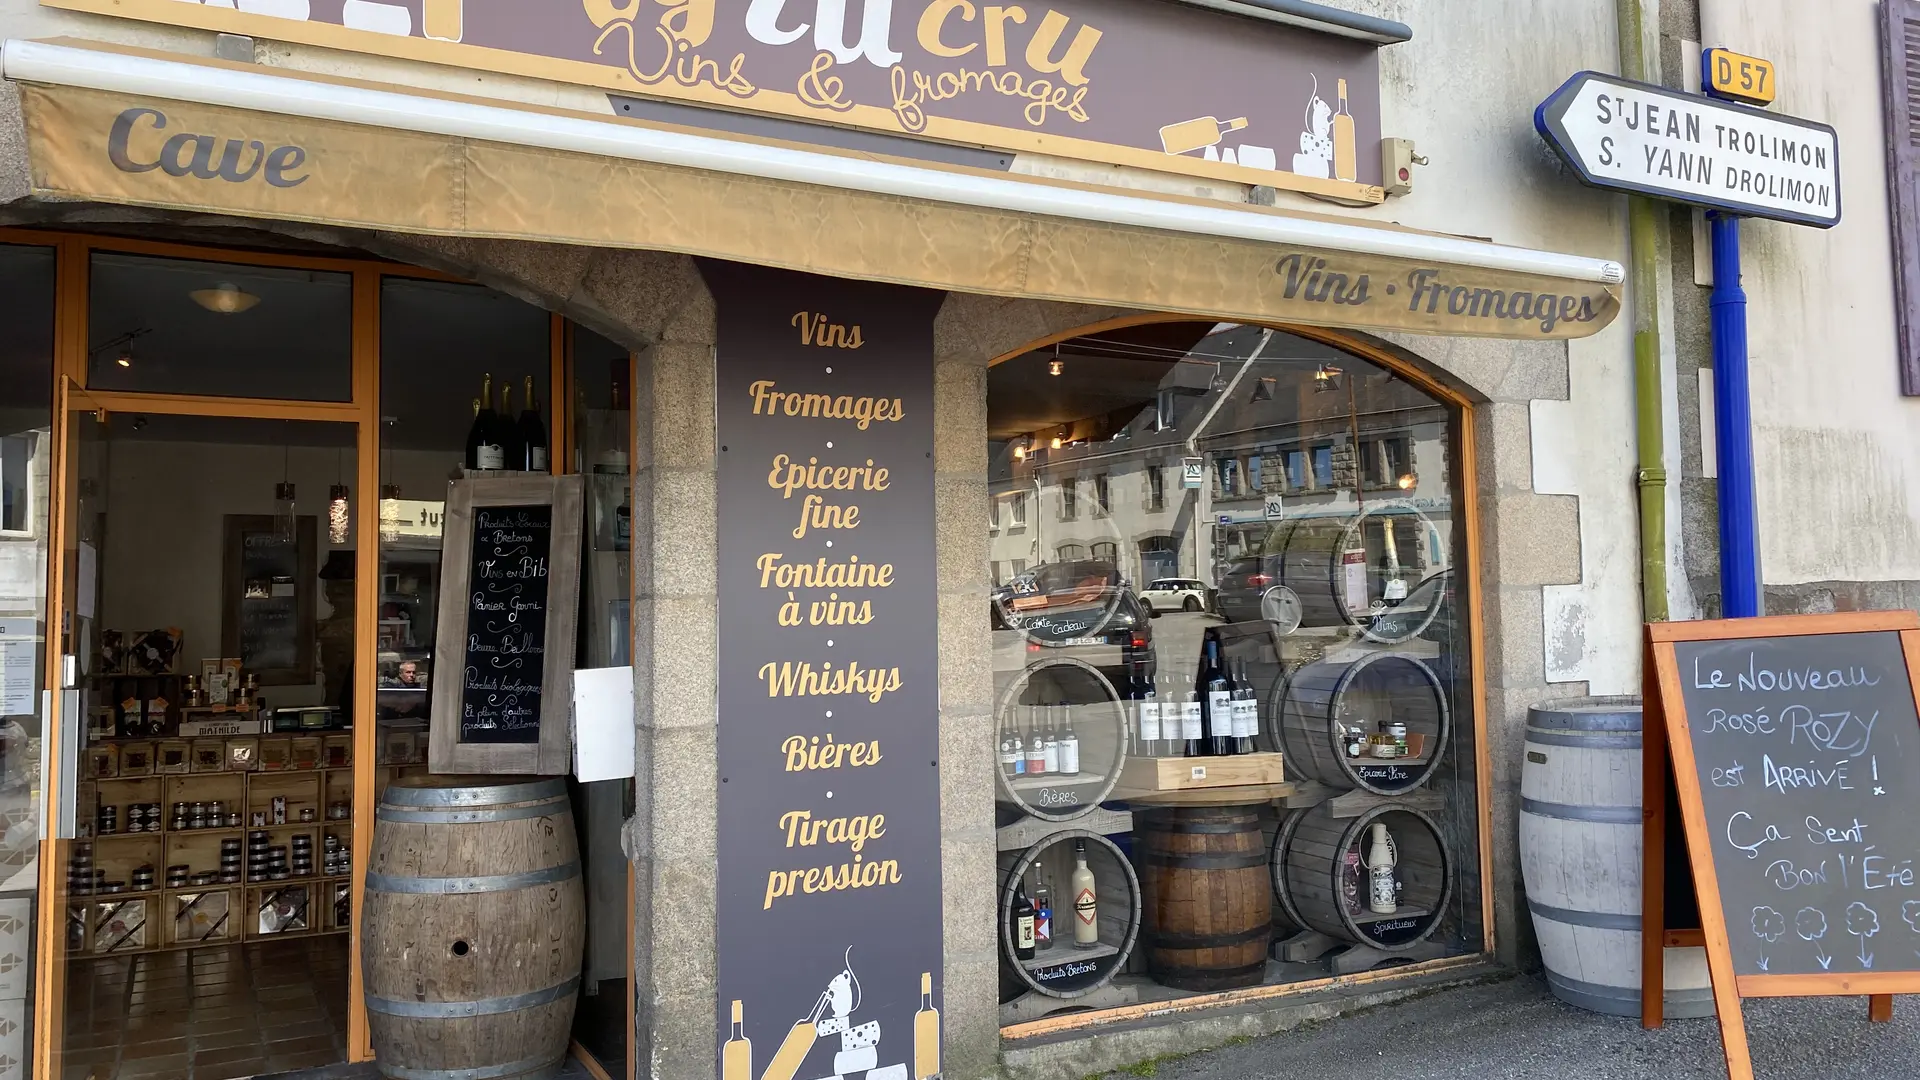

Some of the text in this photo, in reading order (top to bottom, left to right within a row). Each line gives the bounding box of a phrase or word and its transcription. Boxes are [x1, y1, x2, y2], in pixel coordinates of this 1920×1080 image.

[915, 0, 1103, 88] cru
[592, 20, 756, 93] Vins
[797, 51, 853, 109] &
[890, 62, 1091, 132] fromages
[1717, 55, 1768, 94] D 57
[107, 106, 312, 189] Cave
[1714, 124, 1827, 171] TROLIMON
[1598, 136, 1831, 208] S. YANN DROLIMON
[1275, 252, 1600, 334] Vins Fromages
[790, 310, 866, 350] Vins
[748, 379, 906, 432] Fromages
[766, 453, 891, 500] Epicerie
[791, 493, 861, 540] fine
[492, 529, 534, 545] Bretons
[518, 555, 548, 579] Bib
[755, 552, 895, 590] Fontaine
[472, 591, 507, 611] Panier
[777, 591, 876, 627] à vins
[1024, 616, 1088, 635] Carte Cadeau
[464, 665, 498, 691] Produits
[757, 660, 904, 705] Whiskys
[1694, 656, 1732, 689] Le
[199, 726, 242, 736] MATHILDE
[1701, 705, 1776, 735] Rosé
[780, 732, 884, 773] Bières
[1710, 759, 1745, 788] est
[1038, 787, 1079, 808] Bières
[778, 809, 887, 853] Tirage
[1726, 810, 1869, 860] Ça Sent
[762, 853, 903, 911] pression
